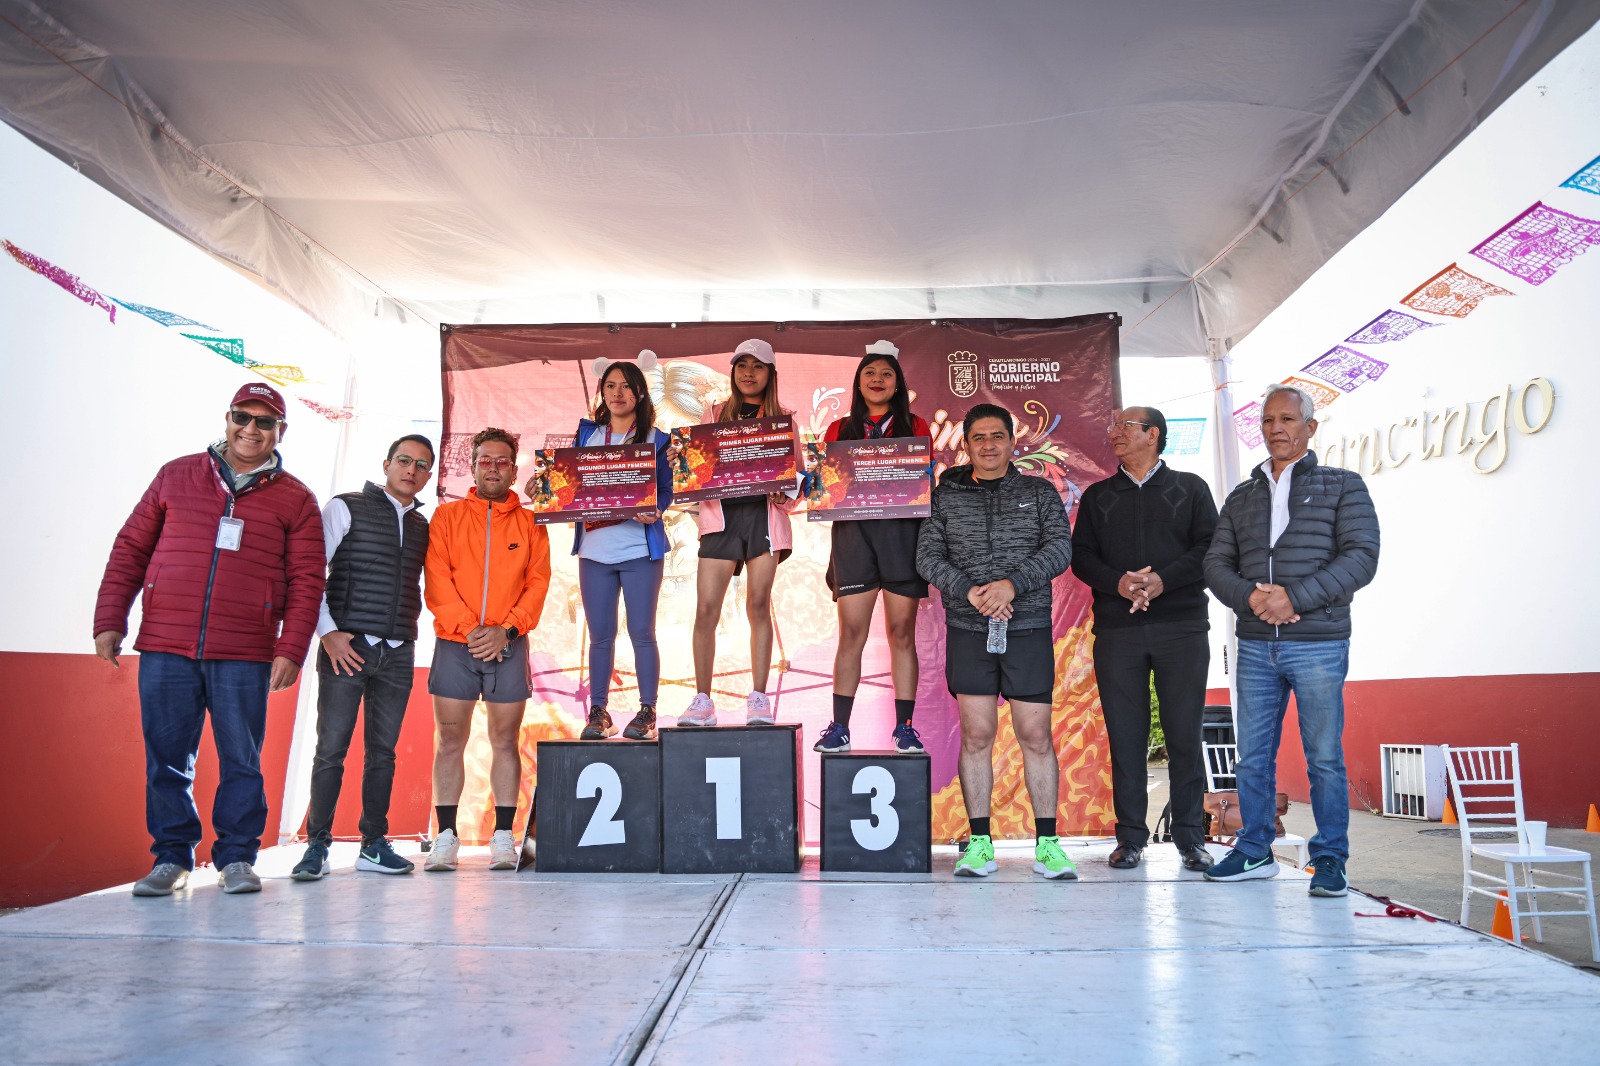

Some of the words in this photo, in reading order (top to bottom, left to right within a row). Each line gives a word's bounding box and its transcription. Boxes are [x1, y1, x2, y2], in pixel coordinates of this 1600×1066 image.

[989, 361, 1060, 373] GOBIERNO
[989, 373, 1061, 383] MUNICIPAL
[576, 762, 626, 847] 2
[706, 756, 742, 840] 1
[850, 765, 900, 851] 3
